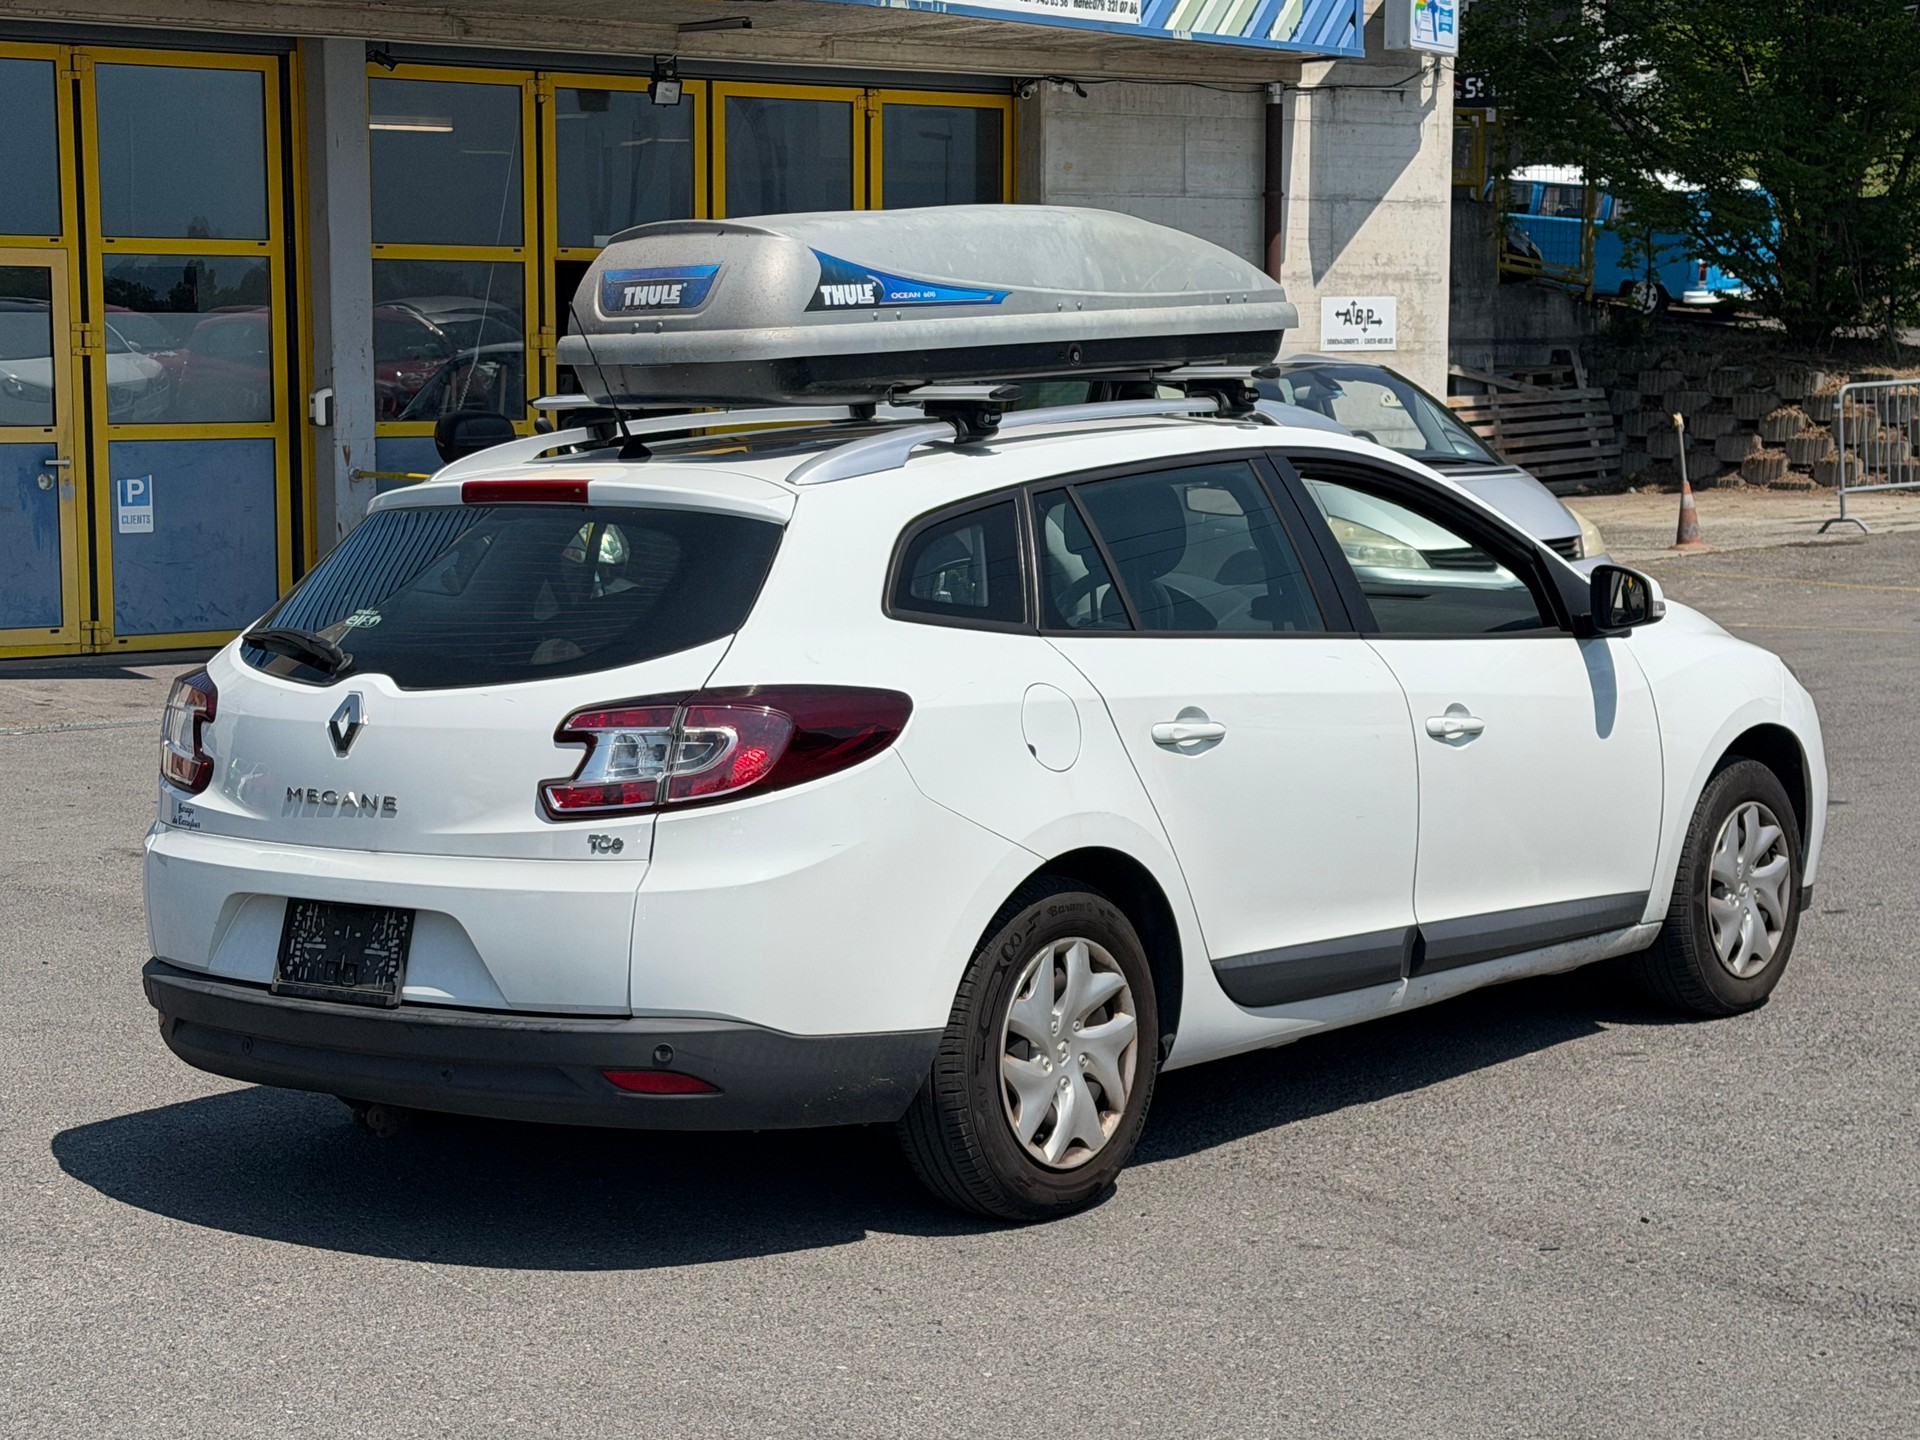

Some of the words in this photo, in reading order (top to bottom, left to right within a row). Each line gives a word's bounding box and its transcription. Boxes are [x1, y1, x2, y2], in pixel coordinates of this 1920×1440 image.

[624, 284, 682, 306] THULE
[820, 283, 875, 306] THULE
[891, 292, 921, 300] OCEAN
[1343, 308, 1375, 326] ABP
[126, 478, 145, 503] P
[121, 515, 151, 525] CLIENTS
[286, 786, 398, 812] MEGANE
